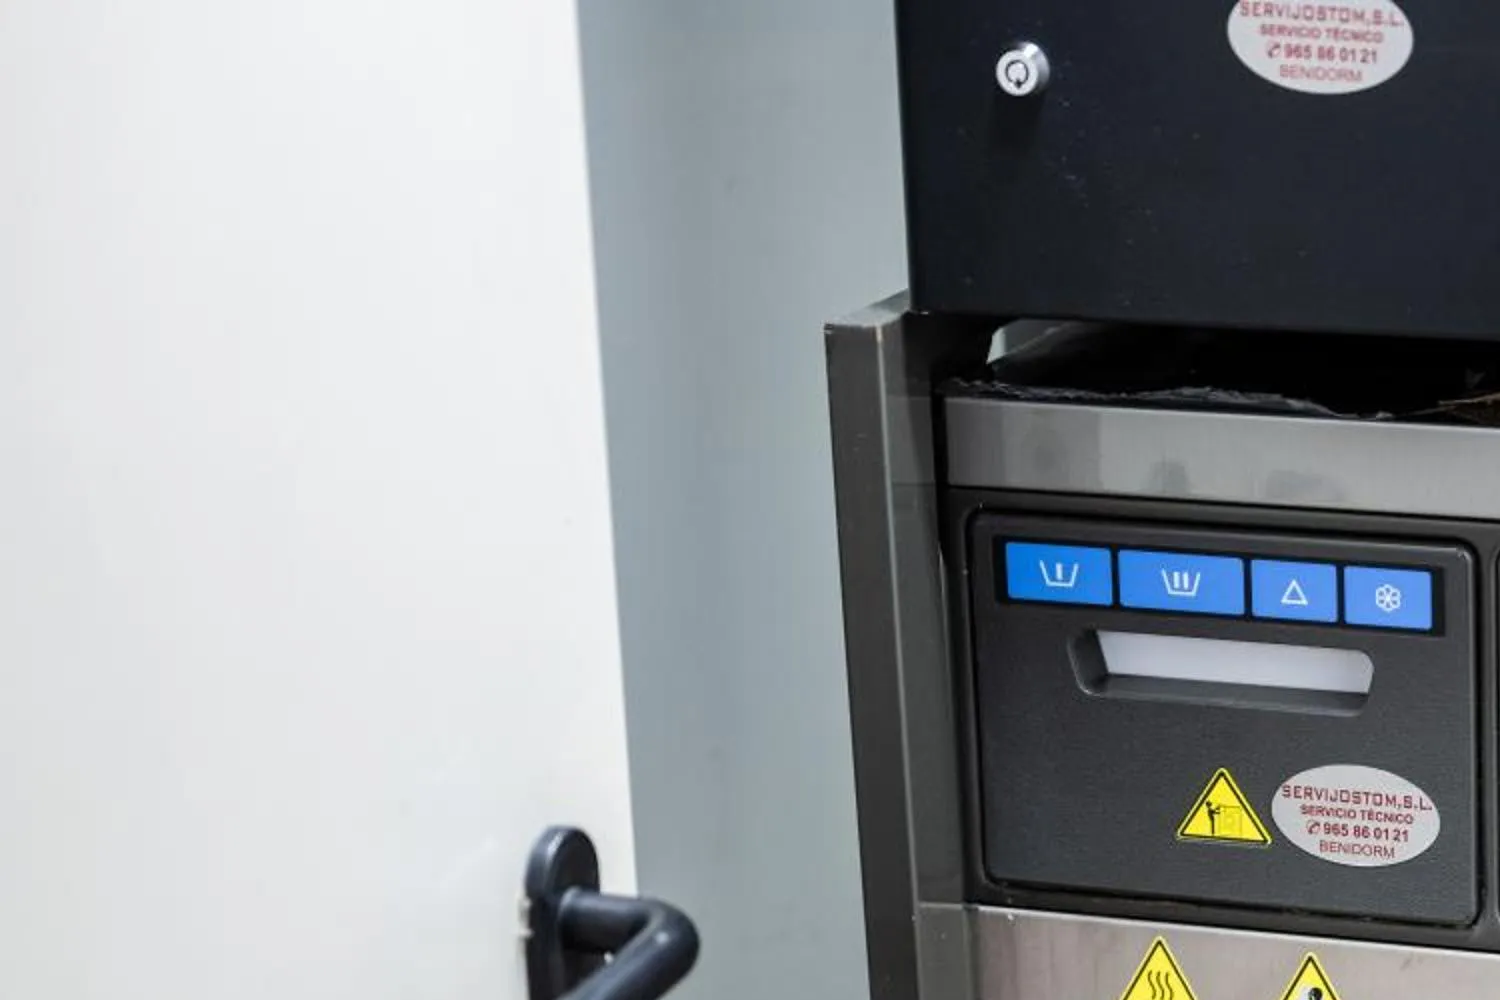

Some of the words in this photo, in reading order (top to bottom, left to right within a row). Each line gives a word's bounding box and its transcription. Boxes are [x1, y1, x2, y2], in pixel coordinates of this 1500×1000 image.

[1260, 24, 1321, 39] SERVICIO
[1325, 26, 1384, 43] TÉCNICO
[1284, 44, 1312, 59] 965
[1317, 46, 1336, 61] 86
[1279, 64, 1363, 82] BENIDORM
[1300, 804, 1356, 819] SERVICIO
[1360, 807, 1414, 824] TÉCNICO
[1323, 822, 1349, 838] 965
[1353, 825, 1370, 839] 86
[1319, 840, 1396, 859] BENIDORM
